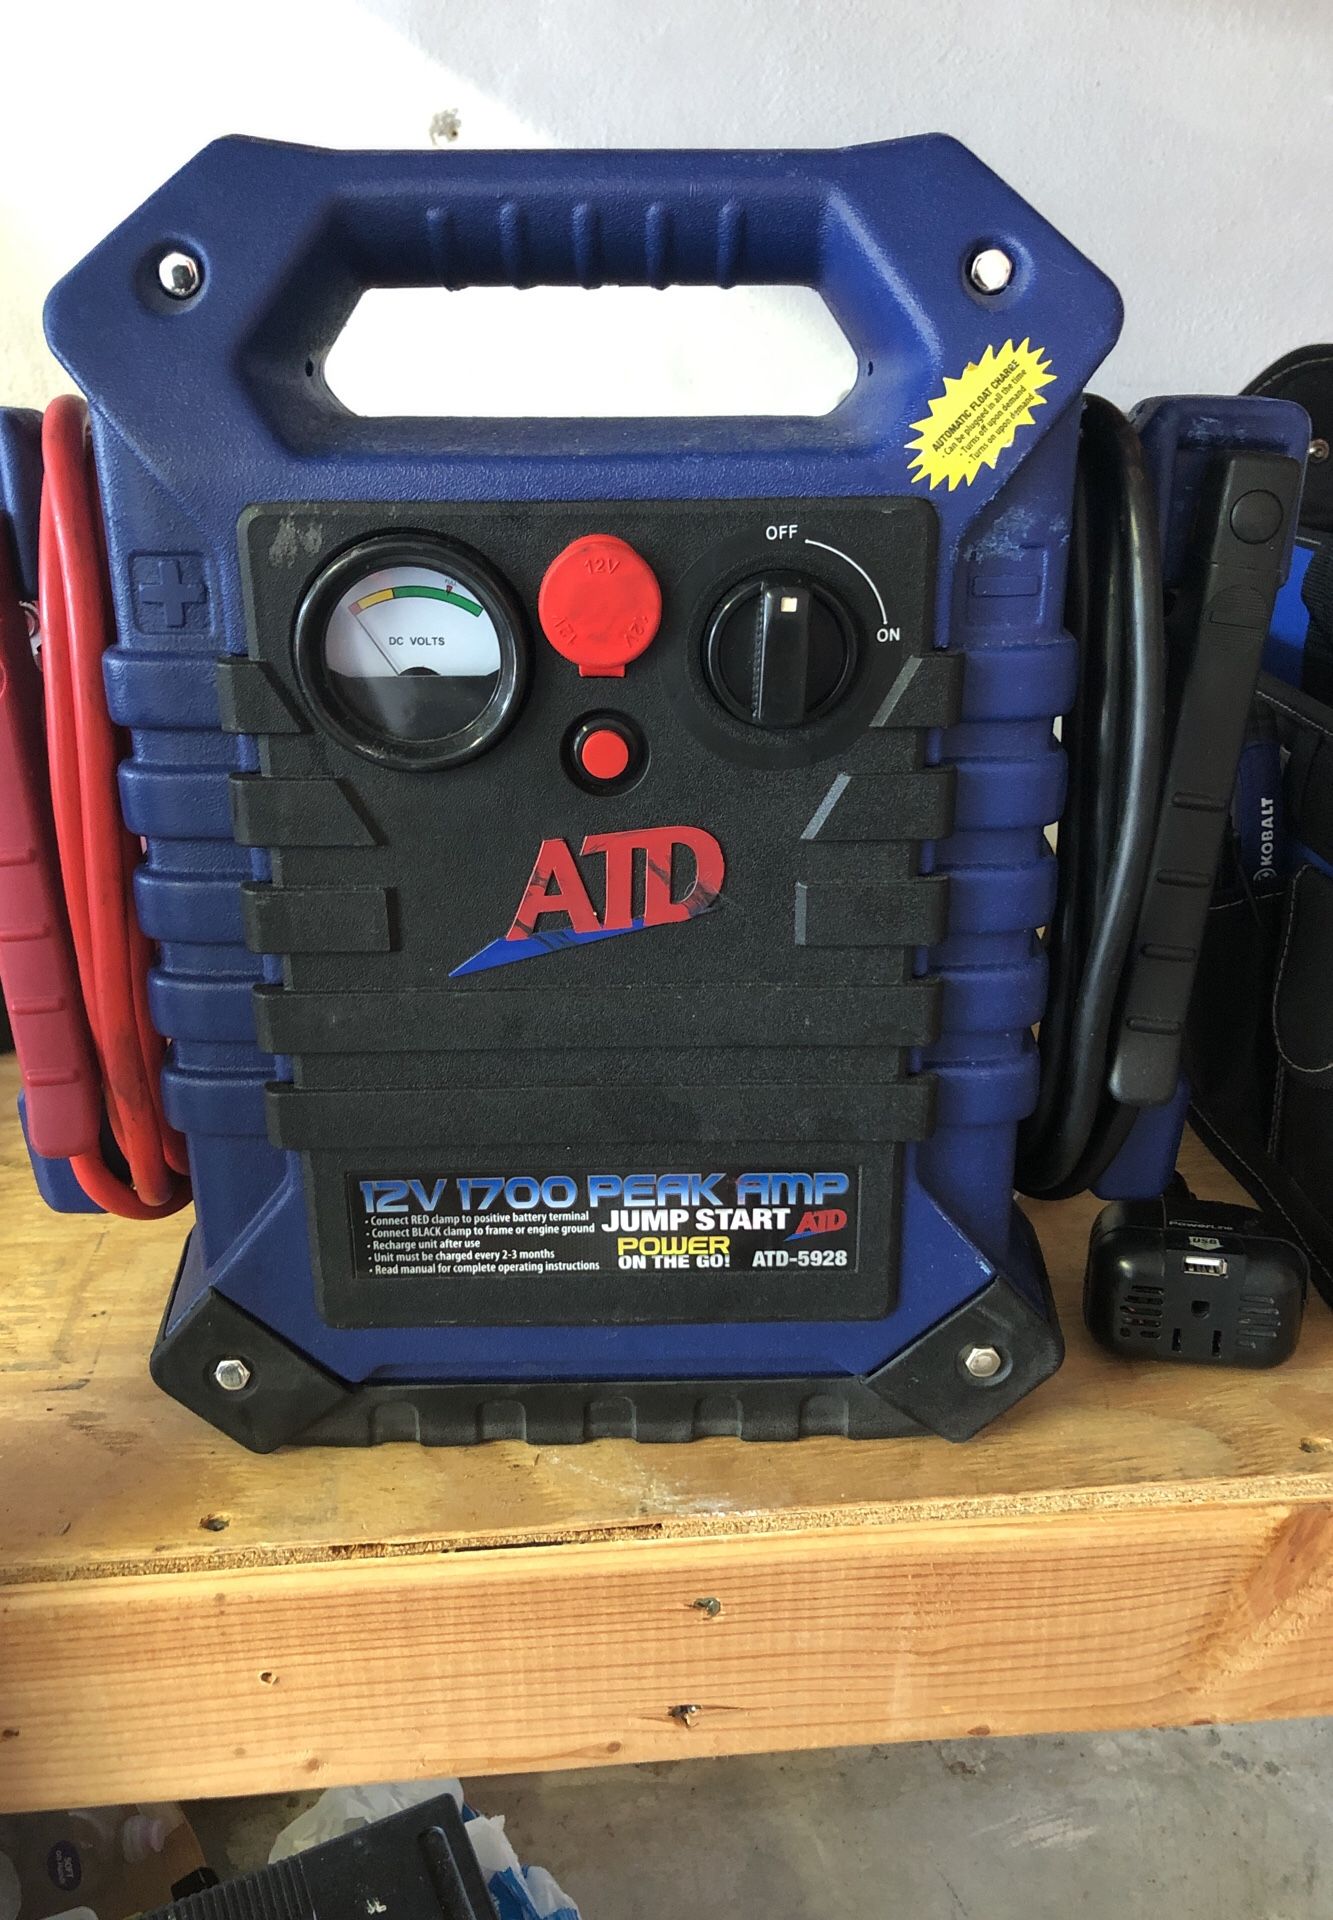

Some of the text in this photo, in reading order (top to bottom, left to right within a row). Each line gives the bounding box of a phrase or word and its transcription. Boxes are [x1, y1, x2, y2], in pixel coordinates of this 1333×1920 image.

[932, 359, 1019, 452] AUTOMATIC FLOAT CHARGE
[944, 369, 1027, 455] Can be plugged in all the time
[961, 385, 1026, 453] Turns off upon demand
[970, 393, 1035, 461] Turns on upon demand
[766, 524, 798, 540] OFF
[584, 558, 620, 575] 12V
[388, 637, 445, 646] DC VOLTS
[877, 628, 900, 642] ON
[1261, 798, 1274, 866] KOBALT
[506, 826, 725, 941] ATD
[359, 1172, 849, 1213] 12V 1700 PEAK AMP
[371, 1211, 589, 1226] Connect RED clamp to positive battery terminal
[602, 1208, 790, 1232] JUMP START
[794, 1209, 847, 1234] ATD
[372, 1228, 410, 1238] Connect
[412, 1227, 441, 1237] BLACK
[443, 1226, 472, 1238] clamp
[473, 1227, 484, 1235] to
[485, 1225, 514, 1235] frame
[527, 1225, 561, 1236] engine
[562, 1223, 595, 1235] ground
[373, 1238, 480, 1251] Recharge unit after use
[618, 1236, 730, 1256] POWER
[374, 1249, 554, 1262] Unit must be charged every 2-3 months
[618, 1254, 730, 1269] ON THE GO!
[752, 1250, 847, 1267] ATD-5928
[375, 1260, 600, 1275] Read manual for complete operating instructions
